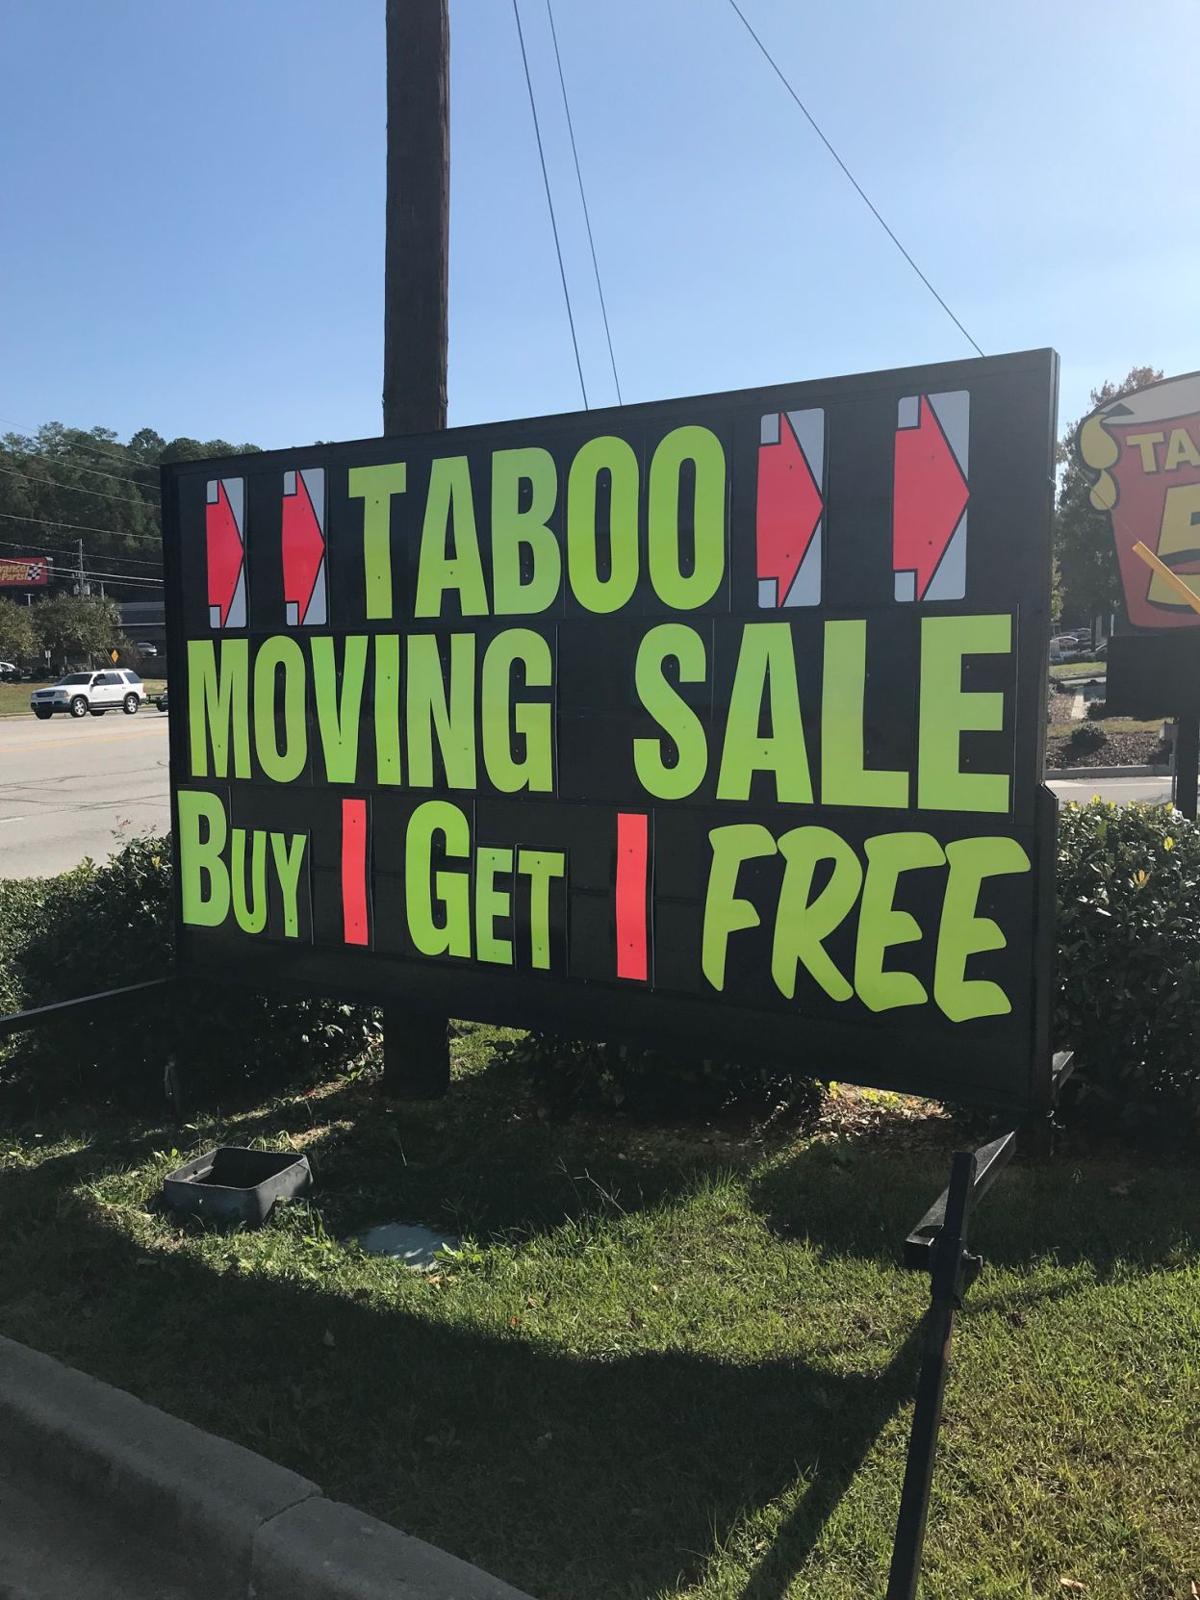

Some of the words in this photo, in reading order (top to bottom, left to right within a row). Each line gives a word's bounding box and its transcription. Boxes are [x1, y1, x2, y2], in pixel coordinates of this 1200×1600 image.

[347, 426, 726, 620] TABOO
[187, 628, 554, 792] MOVING
[633, 615, 1012, 813] SALE
[178, 790, 307, 938] BUY
[406, 801, 566, 970] GET
[702, 823, 1031, 1022] FREE
